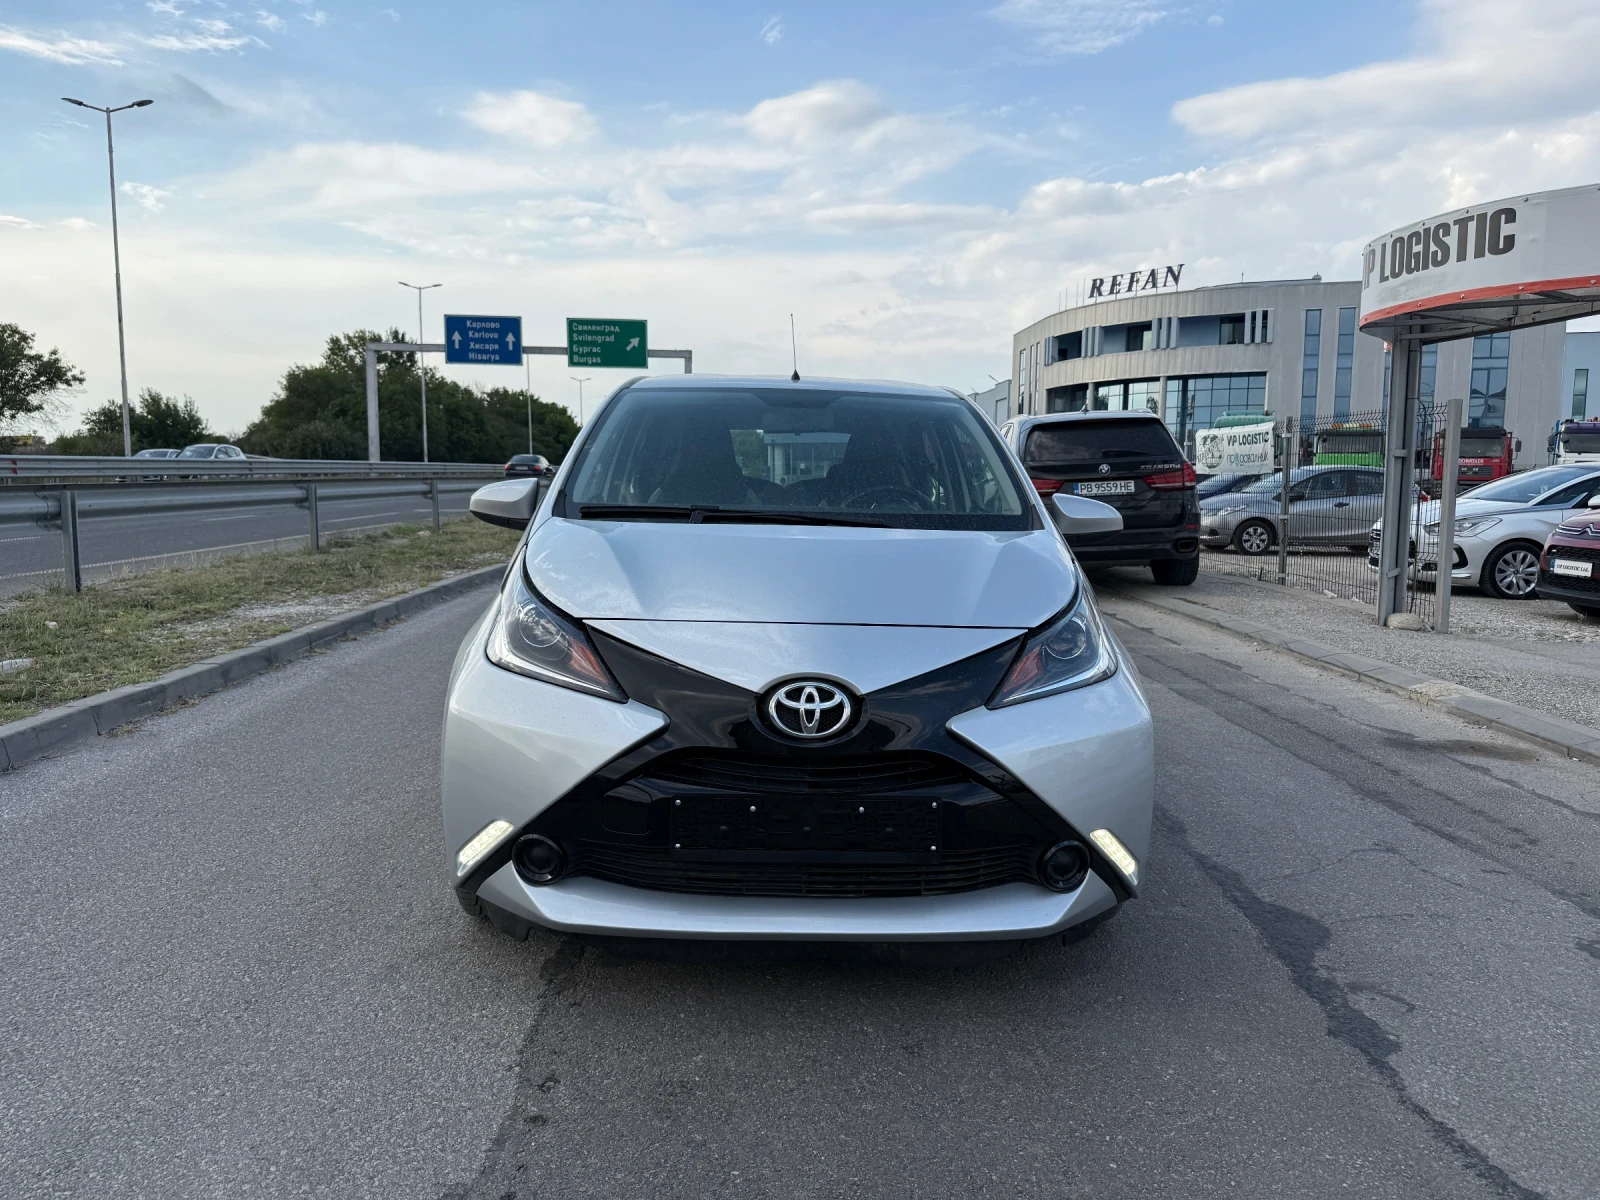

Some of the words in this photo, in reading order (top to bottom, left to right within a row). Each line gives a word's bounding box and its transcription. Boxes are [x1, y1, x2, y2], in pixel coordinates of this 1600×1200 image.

[1379, 207, 1517, 284] LOGISTIC
[1088, 263, 1185, 299] REFAN
[466, 320, 500, 329] Карлово
[572, 323, 620, 333] Свиленград
[468, 330, 499, 339] Karlovo
[572, 333, 615, 343] Svilengrad
[469, 342, 499, 351] Хисаря
[573, 345, 601, 354] Бургас
[468, 352, 500, 361] Hisarya
[573, 355, 601, 364] Burgas
[1238, 431, 1270, 446] LOGISTIC
[1080, 483, 1093, 493] PB
[1095, 482, 1118, 492] 9559
[1119, 481, 1133, 491] HE
